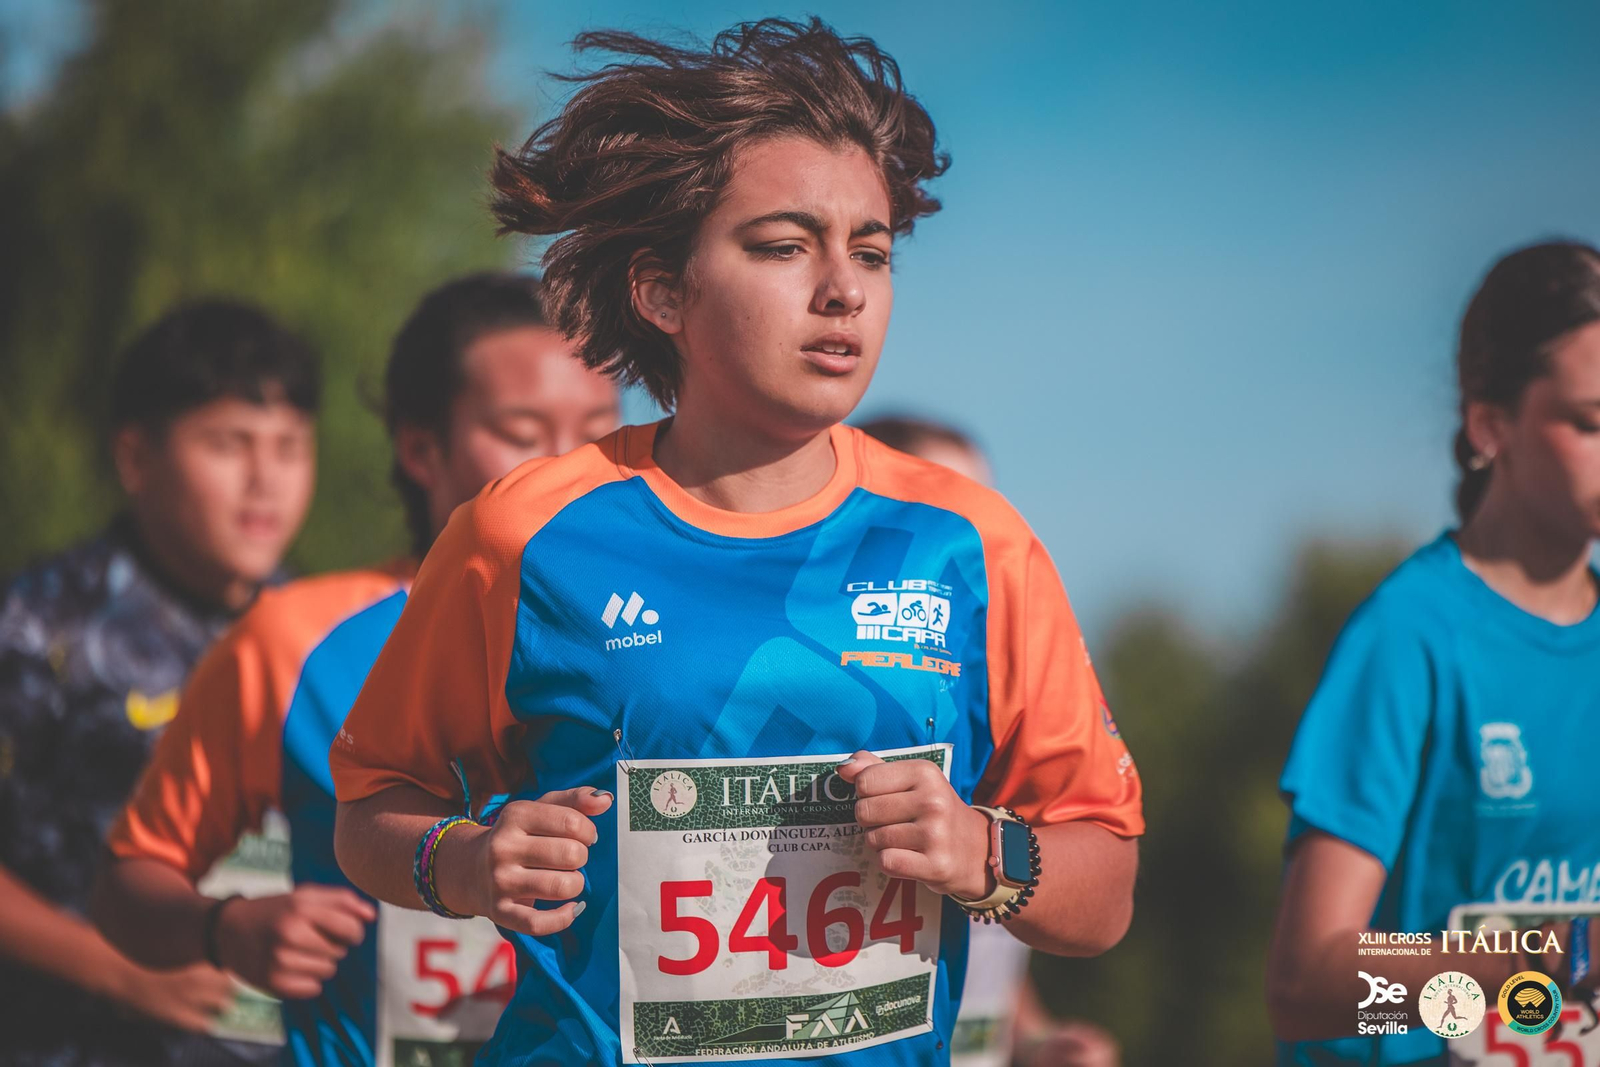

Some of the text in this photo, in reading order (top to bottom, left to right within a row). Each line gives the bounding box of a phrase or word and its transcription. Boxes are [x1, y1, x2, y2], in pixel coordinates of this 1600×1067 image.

[847, 579, 927, 592] CLUB
[605, 630, 662, 651] mobel
[722, 805, 799, 817] INTERNATIONAL
[803, 804, 831, 814] CROSS
[682, 828, 737, 844] GARCÍA
[768, 842, 831, 853] CLUB CAPA
[658, 870, 923, 976] 5464
[695, 1031, 875, 1056] FEDERACIÓN ANDALUZA DE ATLETISMO
